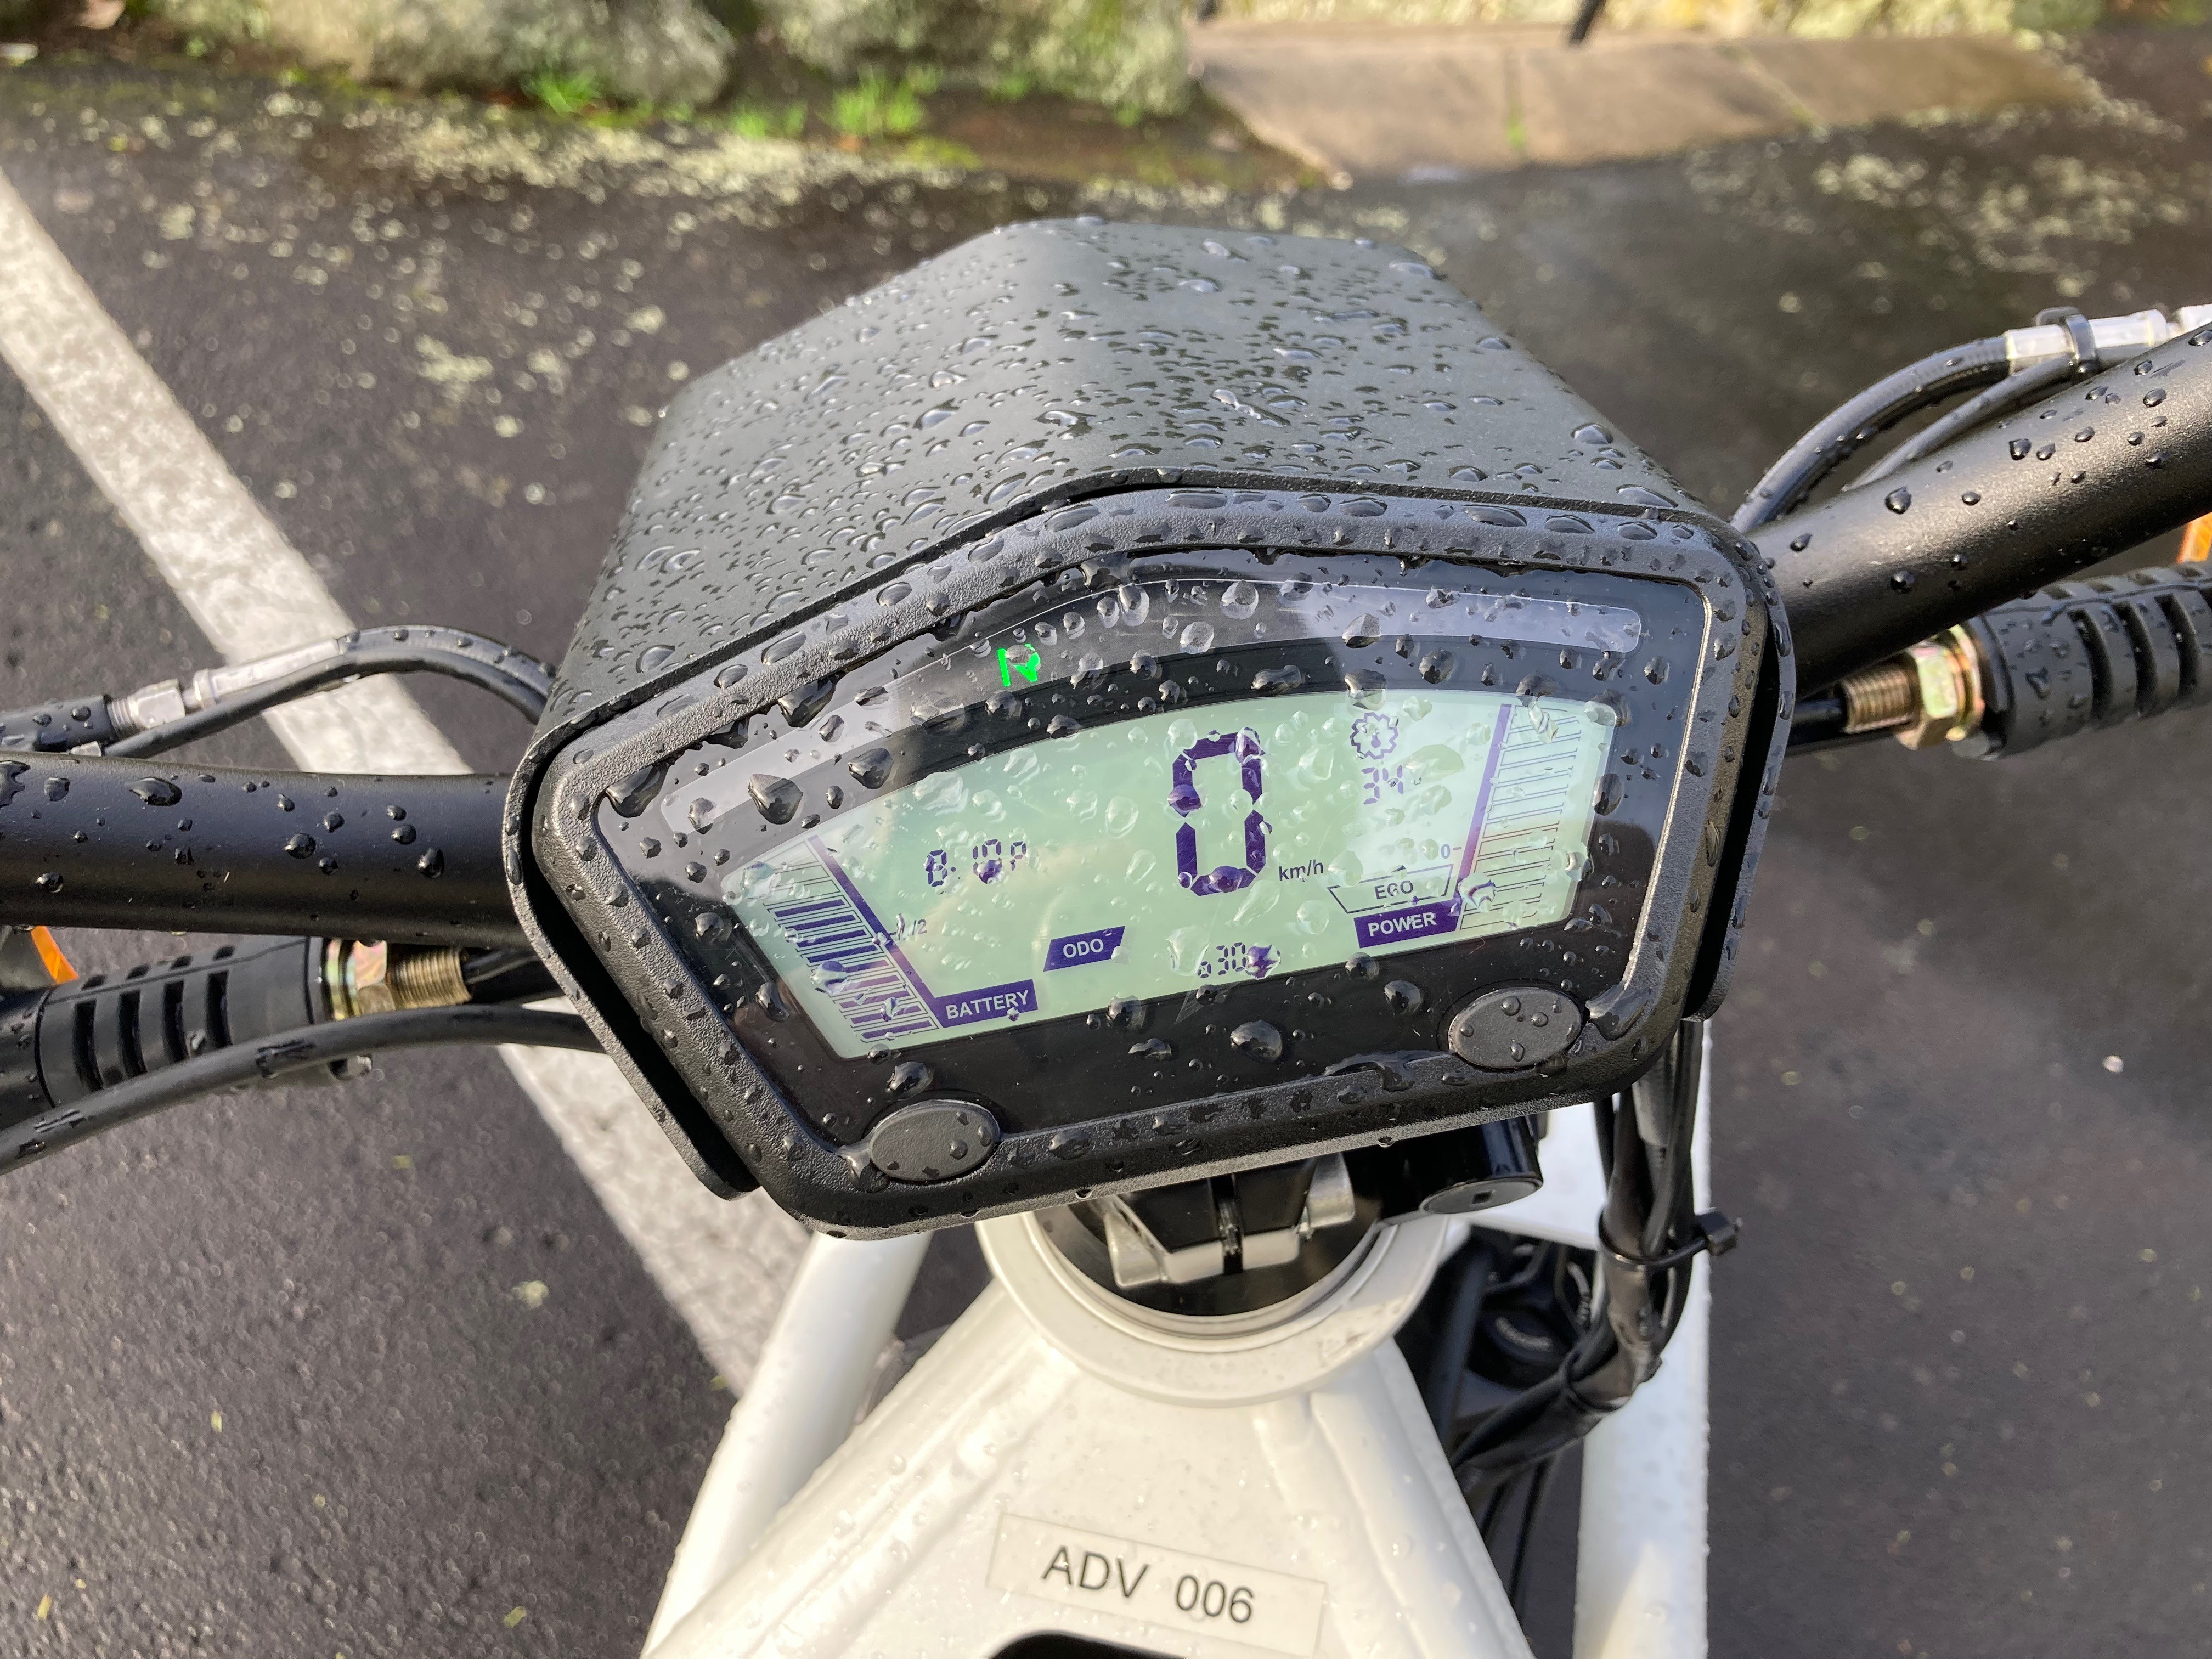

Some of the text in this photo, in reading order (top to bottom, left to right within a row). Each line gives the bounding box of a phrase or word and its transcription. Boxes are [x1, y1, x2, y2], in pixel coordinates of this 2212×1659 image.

[1278, 859, 1324, 882] km/h
[1368, 912, 1437, 937] POWER
[1062, 938, 1104, 958] ODO
[945, 990, 1029, 1020] BATTERY
[1041, 1544, 1255, 1624] ADV 006
